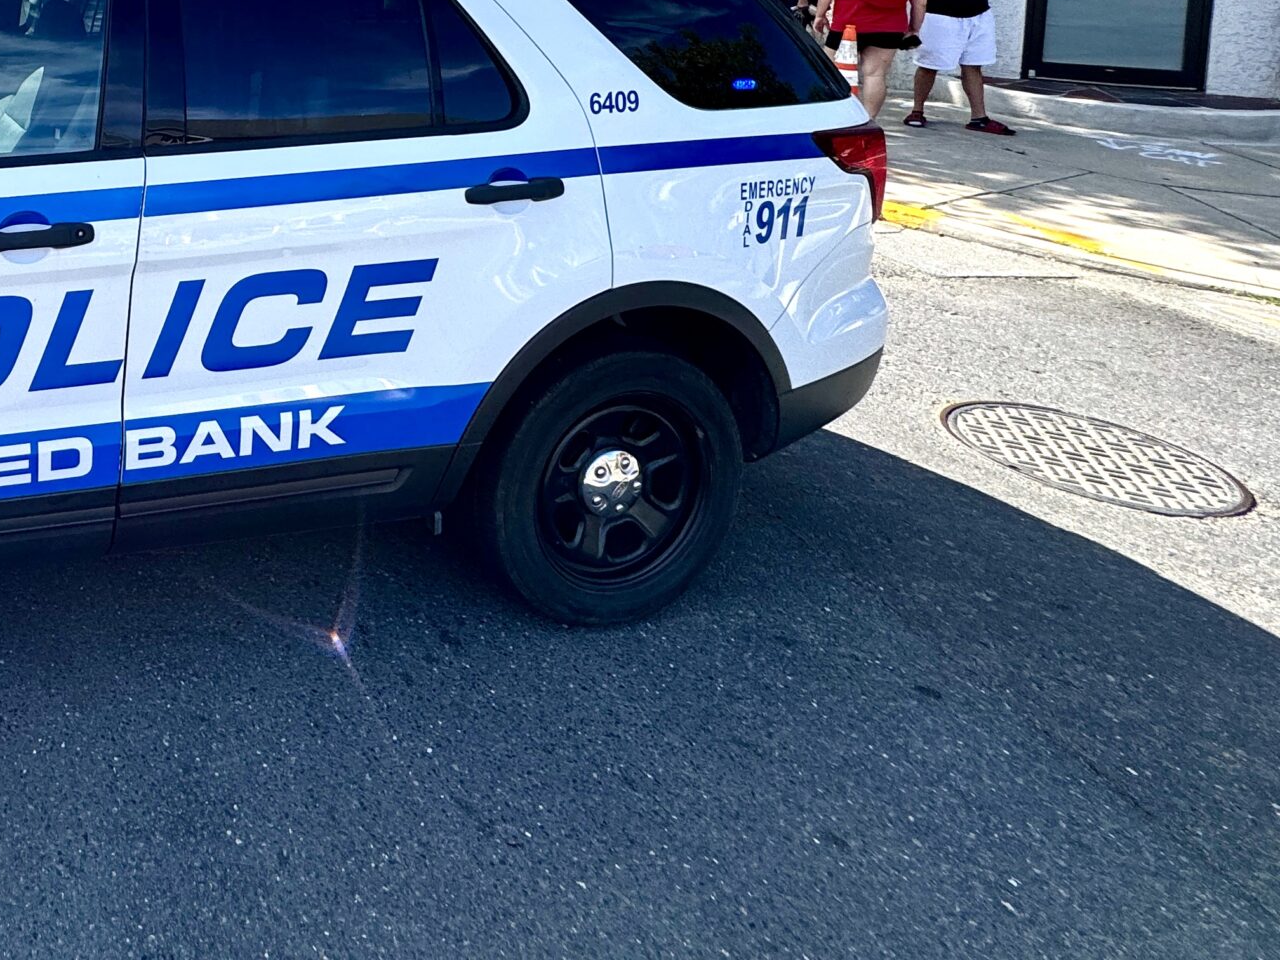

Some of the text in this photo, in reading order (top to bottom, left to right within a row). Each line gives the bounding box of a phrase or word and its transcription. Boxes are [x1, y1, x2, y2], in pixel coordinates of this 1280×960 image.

[589, 90, 640, 114] 6409
[740, 176, 816, 200] EMERGENCY
[742, 201, 753, 247] DIAL
[755, 195, 809, 244] 911
[125, 404, 347, 471] BANK
